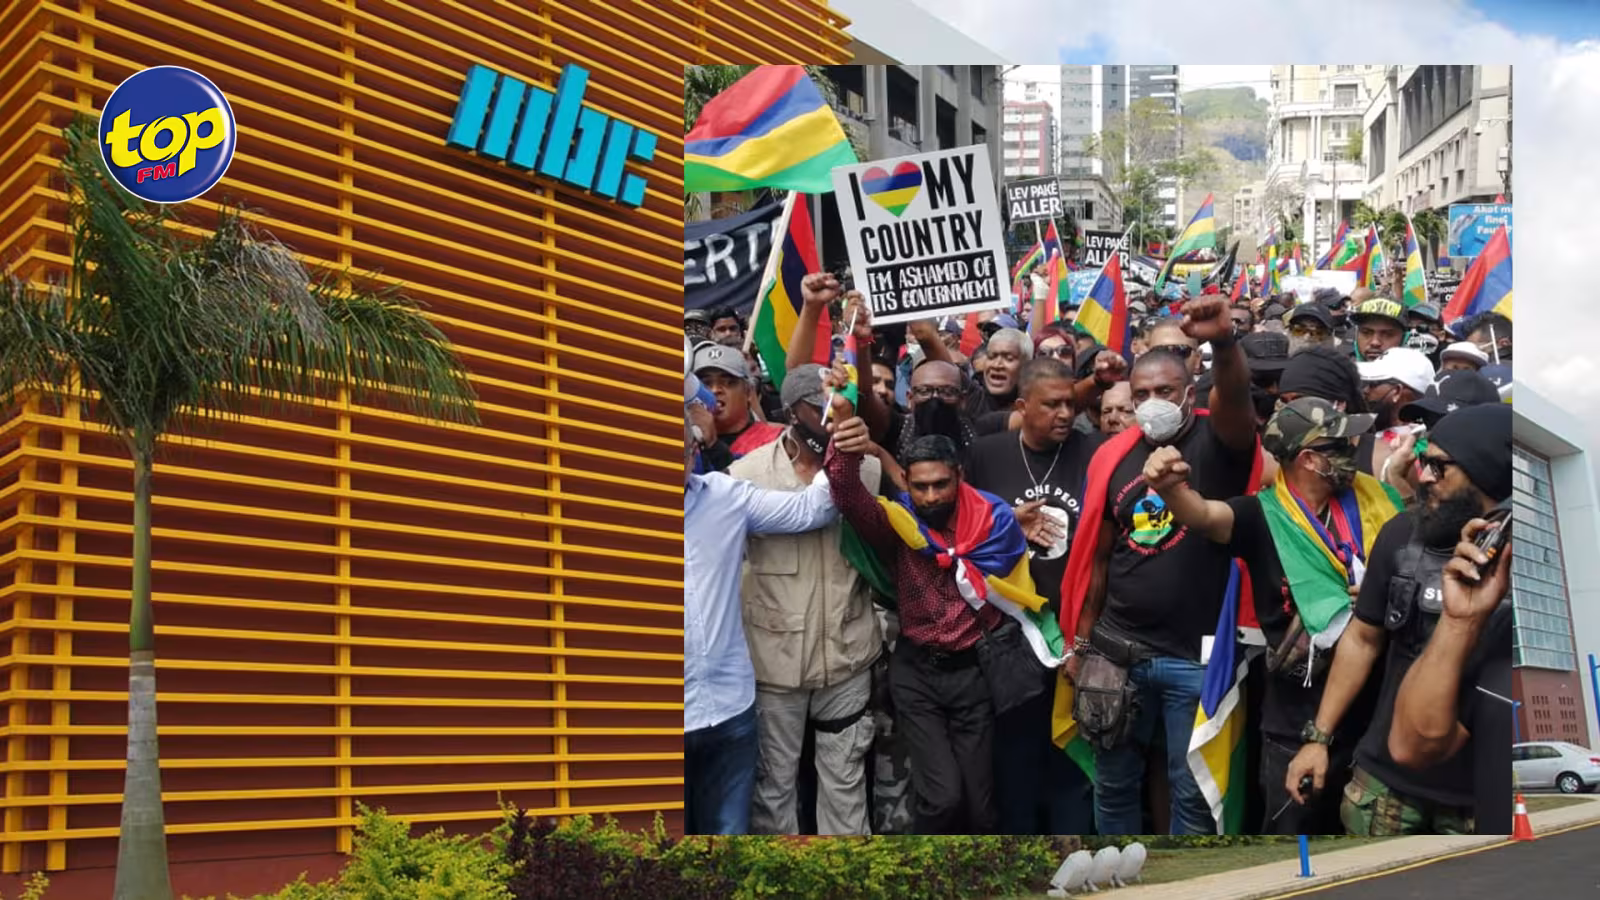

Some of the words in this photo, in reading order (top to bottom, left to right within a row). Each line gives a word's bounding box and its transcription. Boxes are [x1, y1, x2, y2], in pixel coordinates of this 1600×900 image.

[849, 172, 865, 221] I
[922, 153, 975, 209] MY
[1009, 186, 1028, 200] LEV
[1030, 181, 1059, 198] PAKÉ
[1011, 197, 1061, 218] ALLER
[860, 209, 983, 264] COUNTRY
[1086, 235, 1104, 249] LEV
[1085, 249, 1129, 268] ALLR
[899, 261, 969, 289] ASHAMED
[973, 256, 993, 277] OF
[872, 291, 898, 313] ITS
[1025, 484, 1050, 499] ONE
